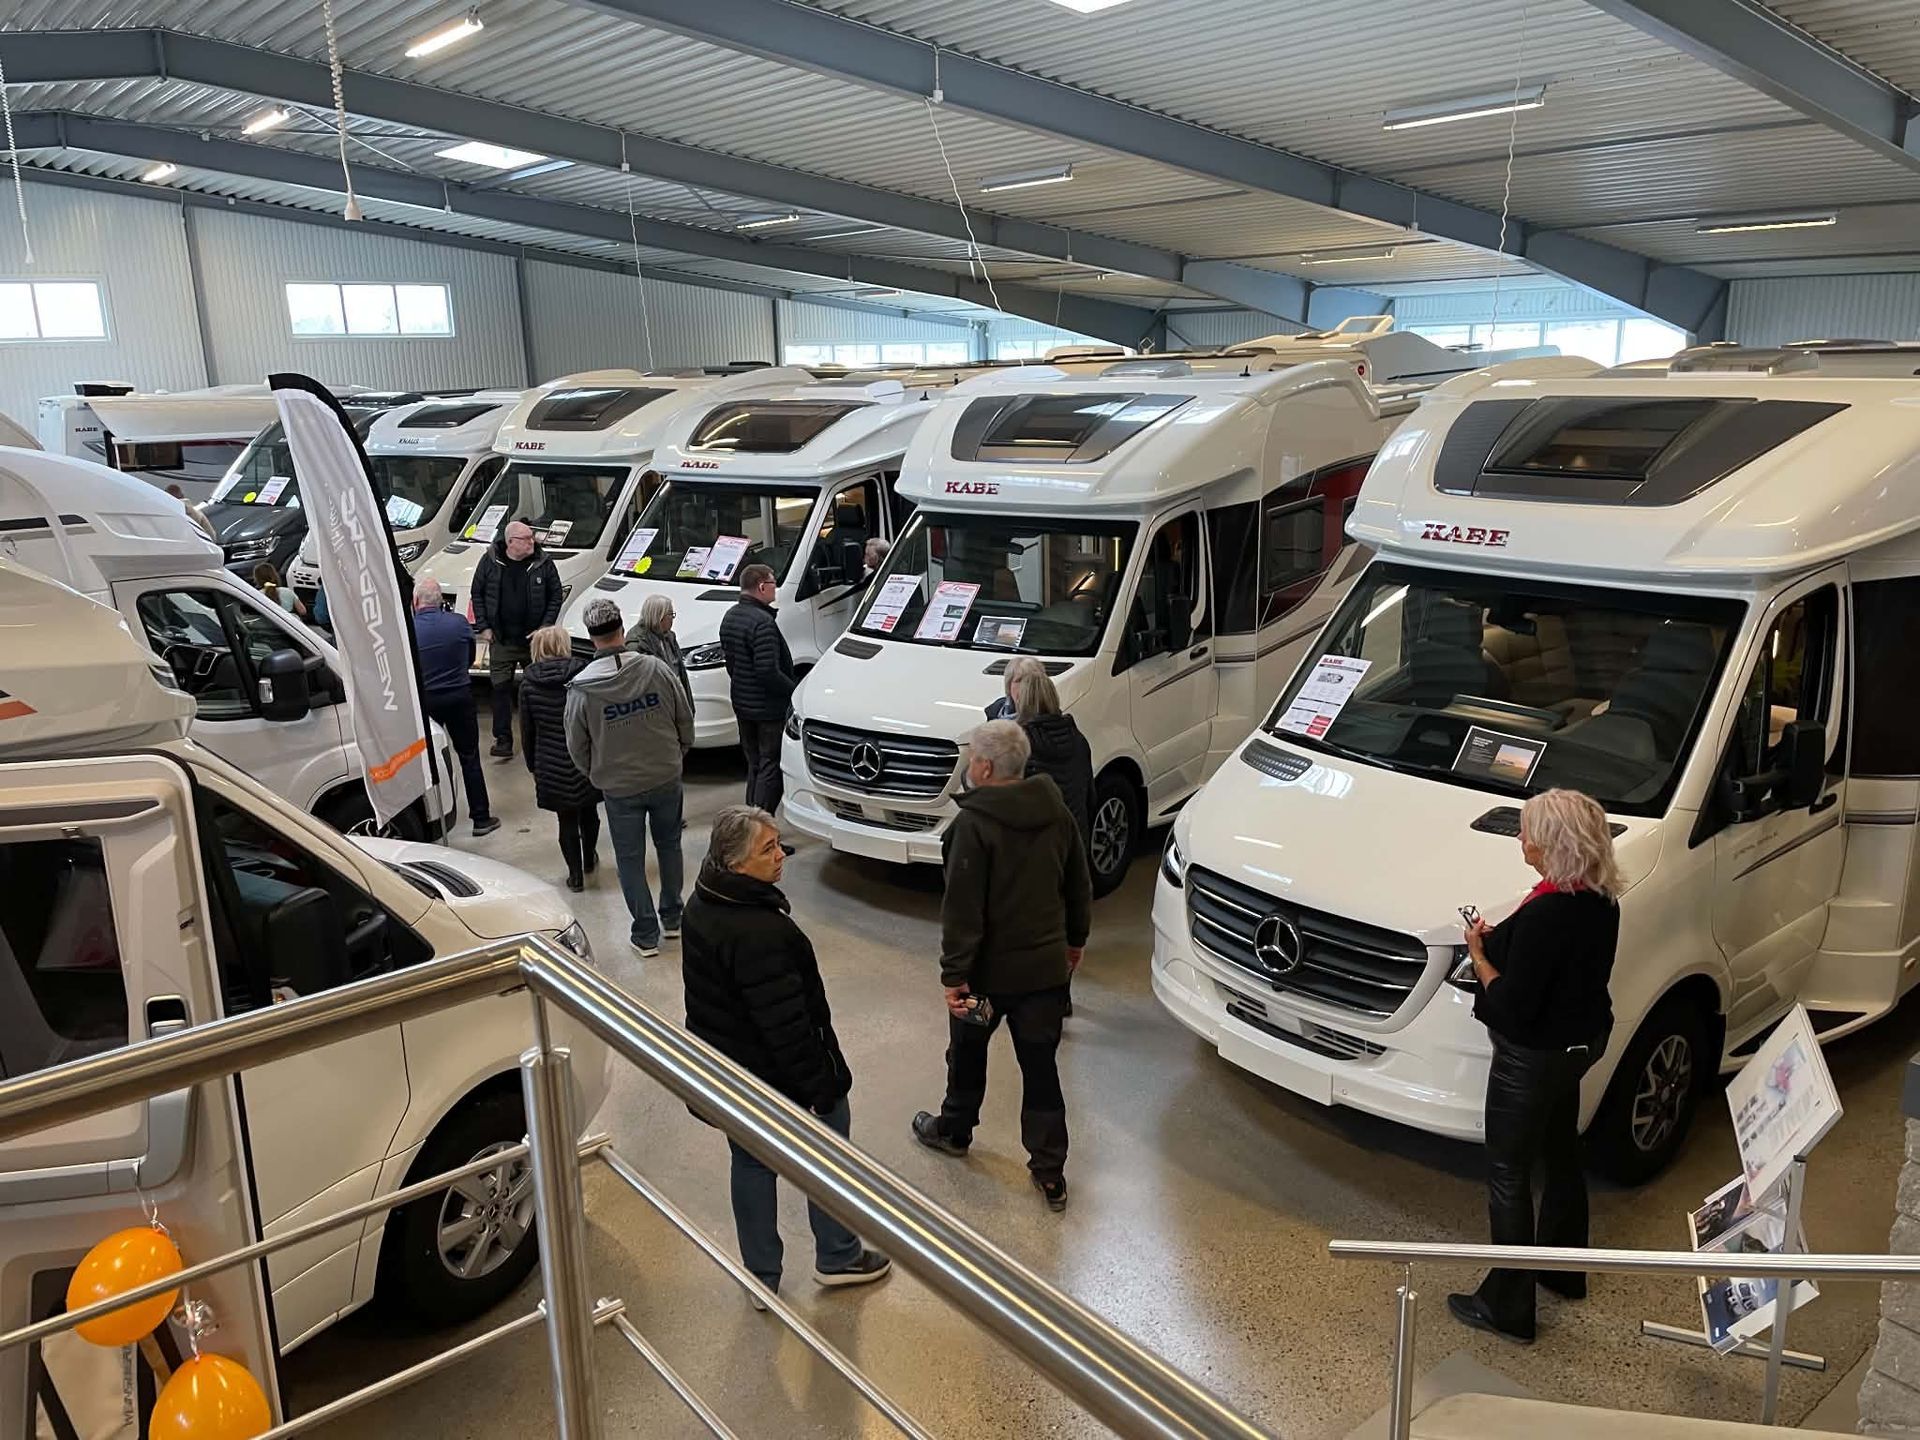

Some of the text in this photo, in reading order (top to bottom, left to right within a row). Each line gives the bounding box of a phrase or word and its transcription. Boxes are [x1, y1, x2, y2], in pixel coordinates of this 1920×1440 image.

[515, 441, 545, 450] KABE
[681, 461, 719, 469] KABE
[945, 481, 1000, 495] KABE
[1421, 523, 1510, 546] KABE
